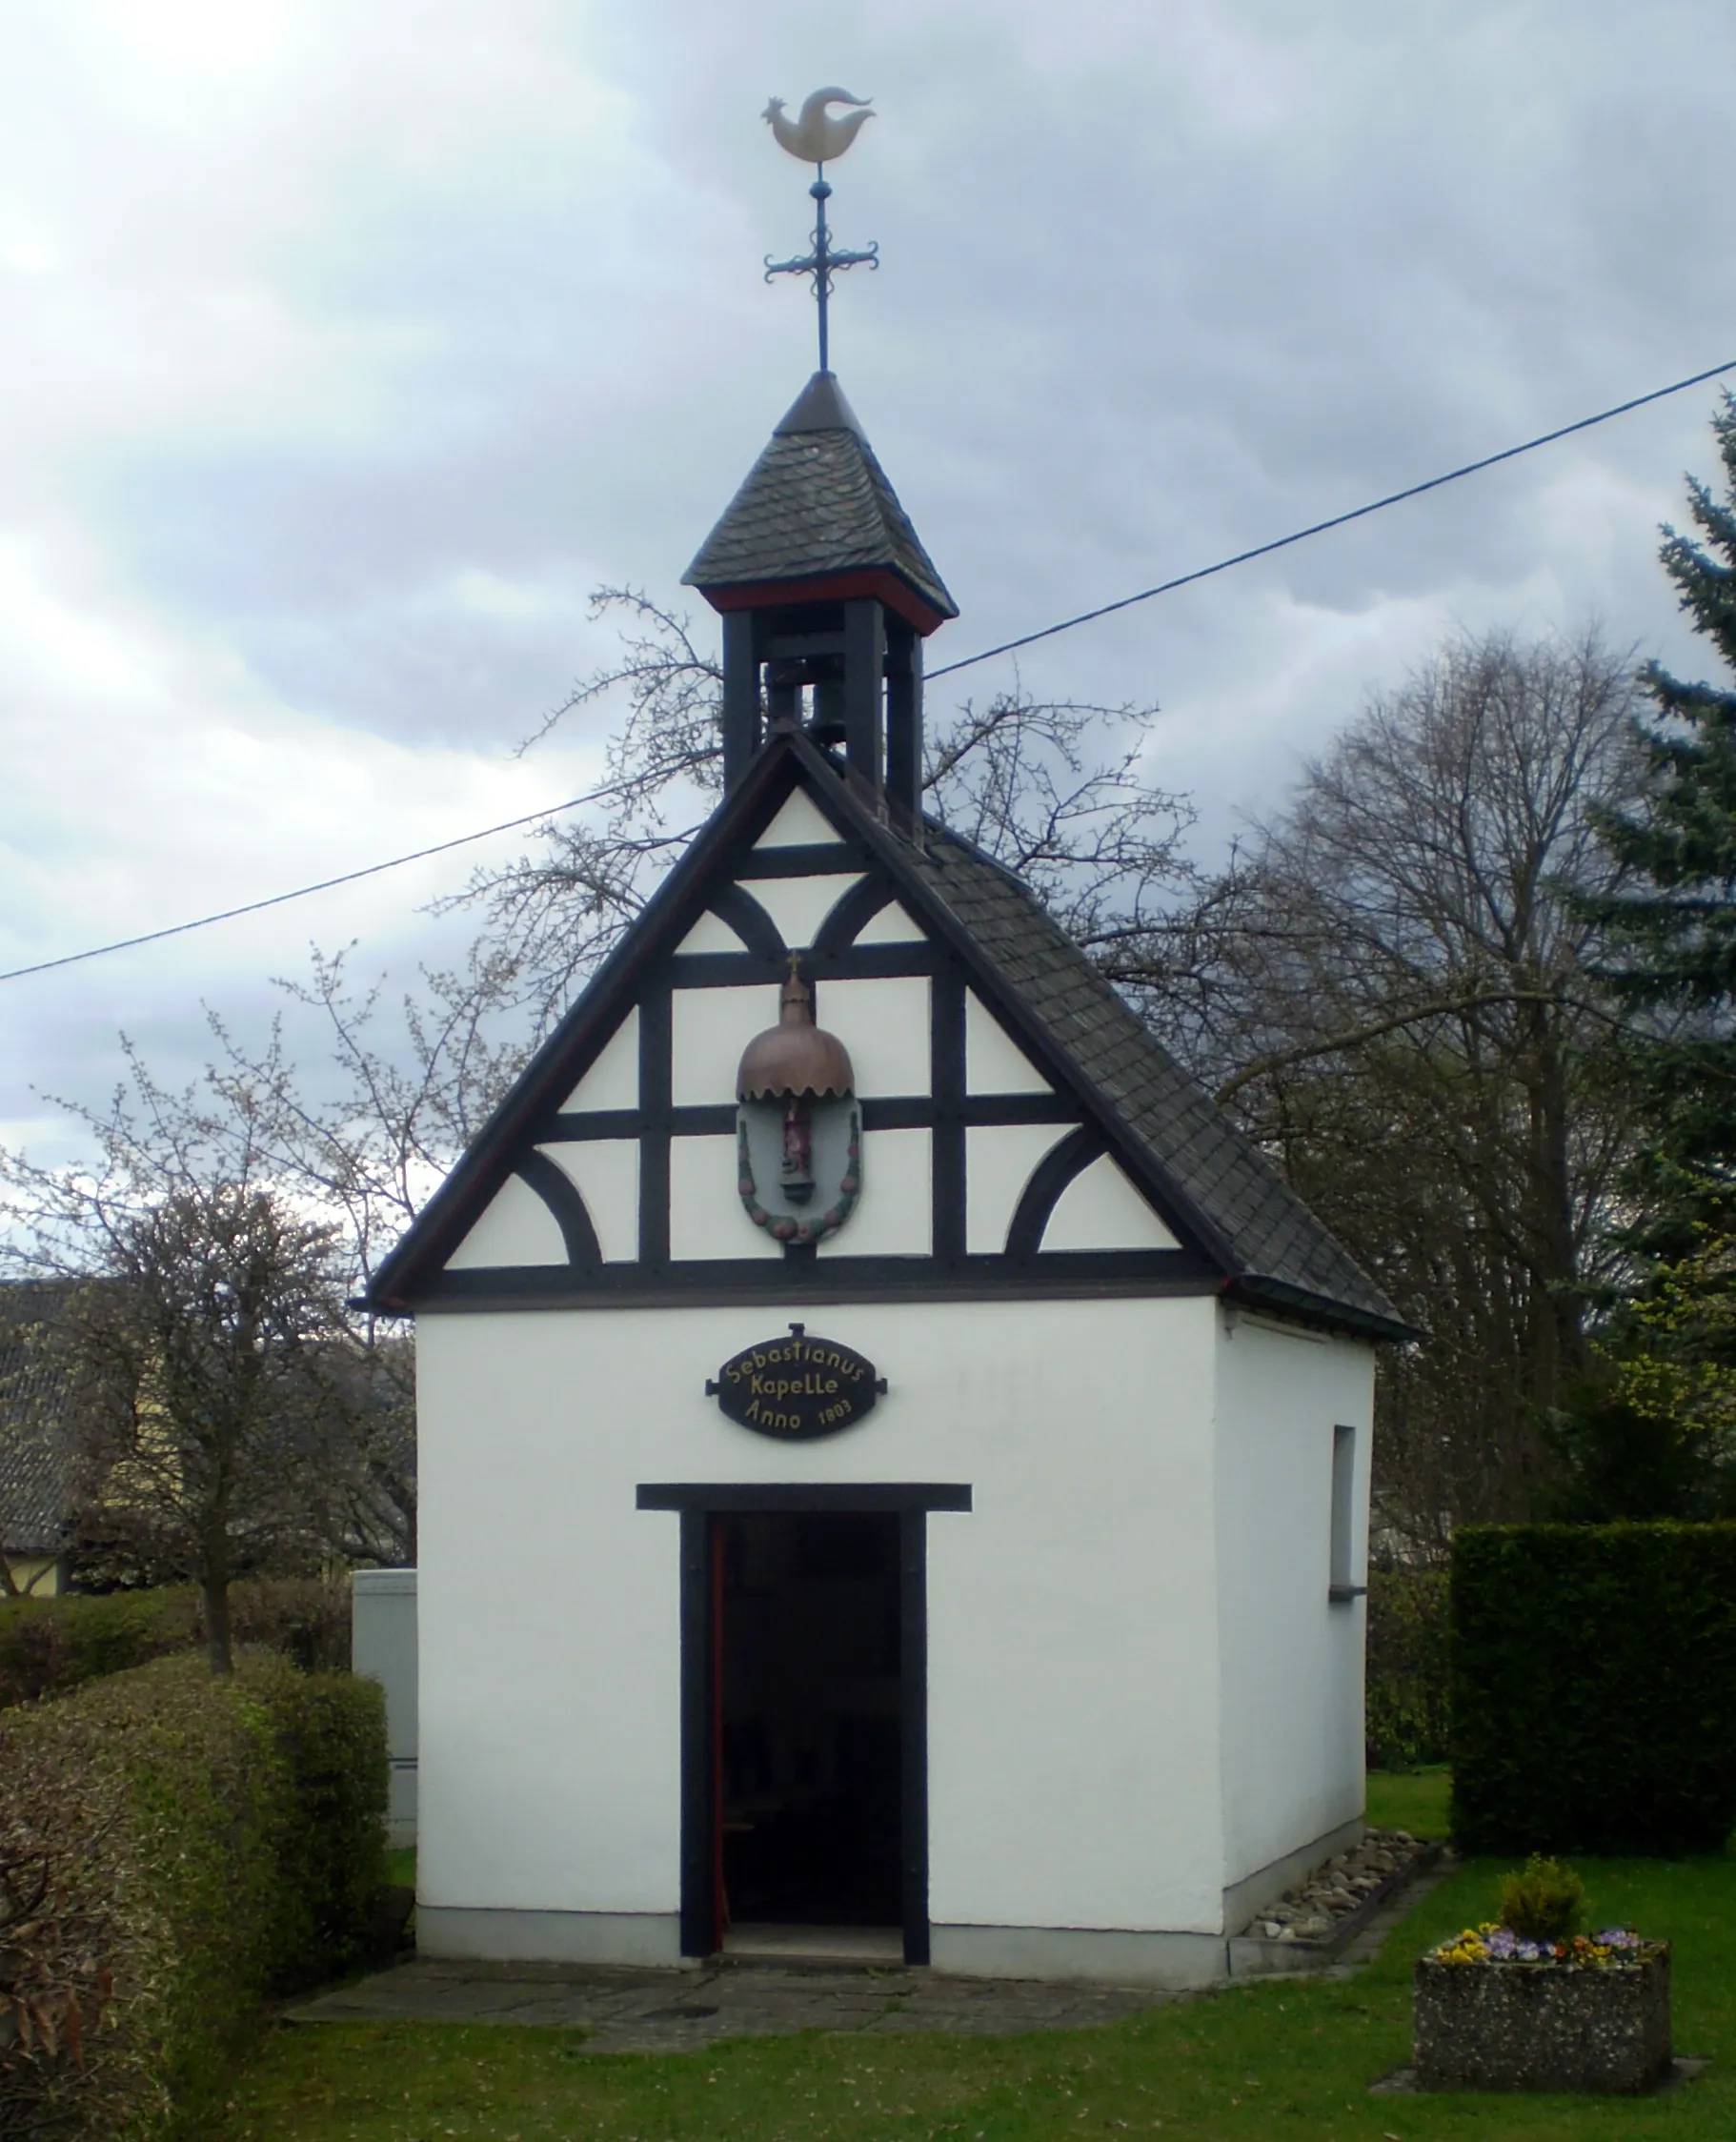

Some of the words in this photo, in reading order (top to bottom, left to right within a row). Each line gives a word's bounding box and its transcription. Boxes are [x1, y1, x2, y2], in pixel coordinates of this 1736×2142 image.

[725, 1341, 865, 1384] Sebastianus
[751, 1373, 839, 1401] Kapelle
[744, 1399, 801, 1428] Anno
[818, 1399, 853, 1425] 1803
